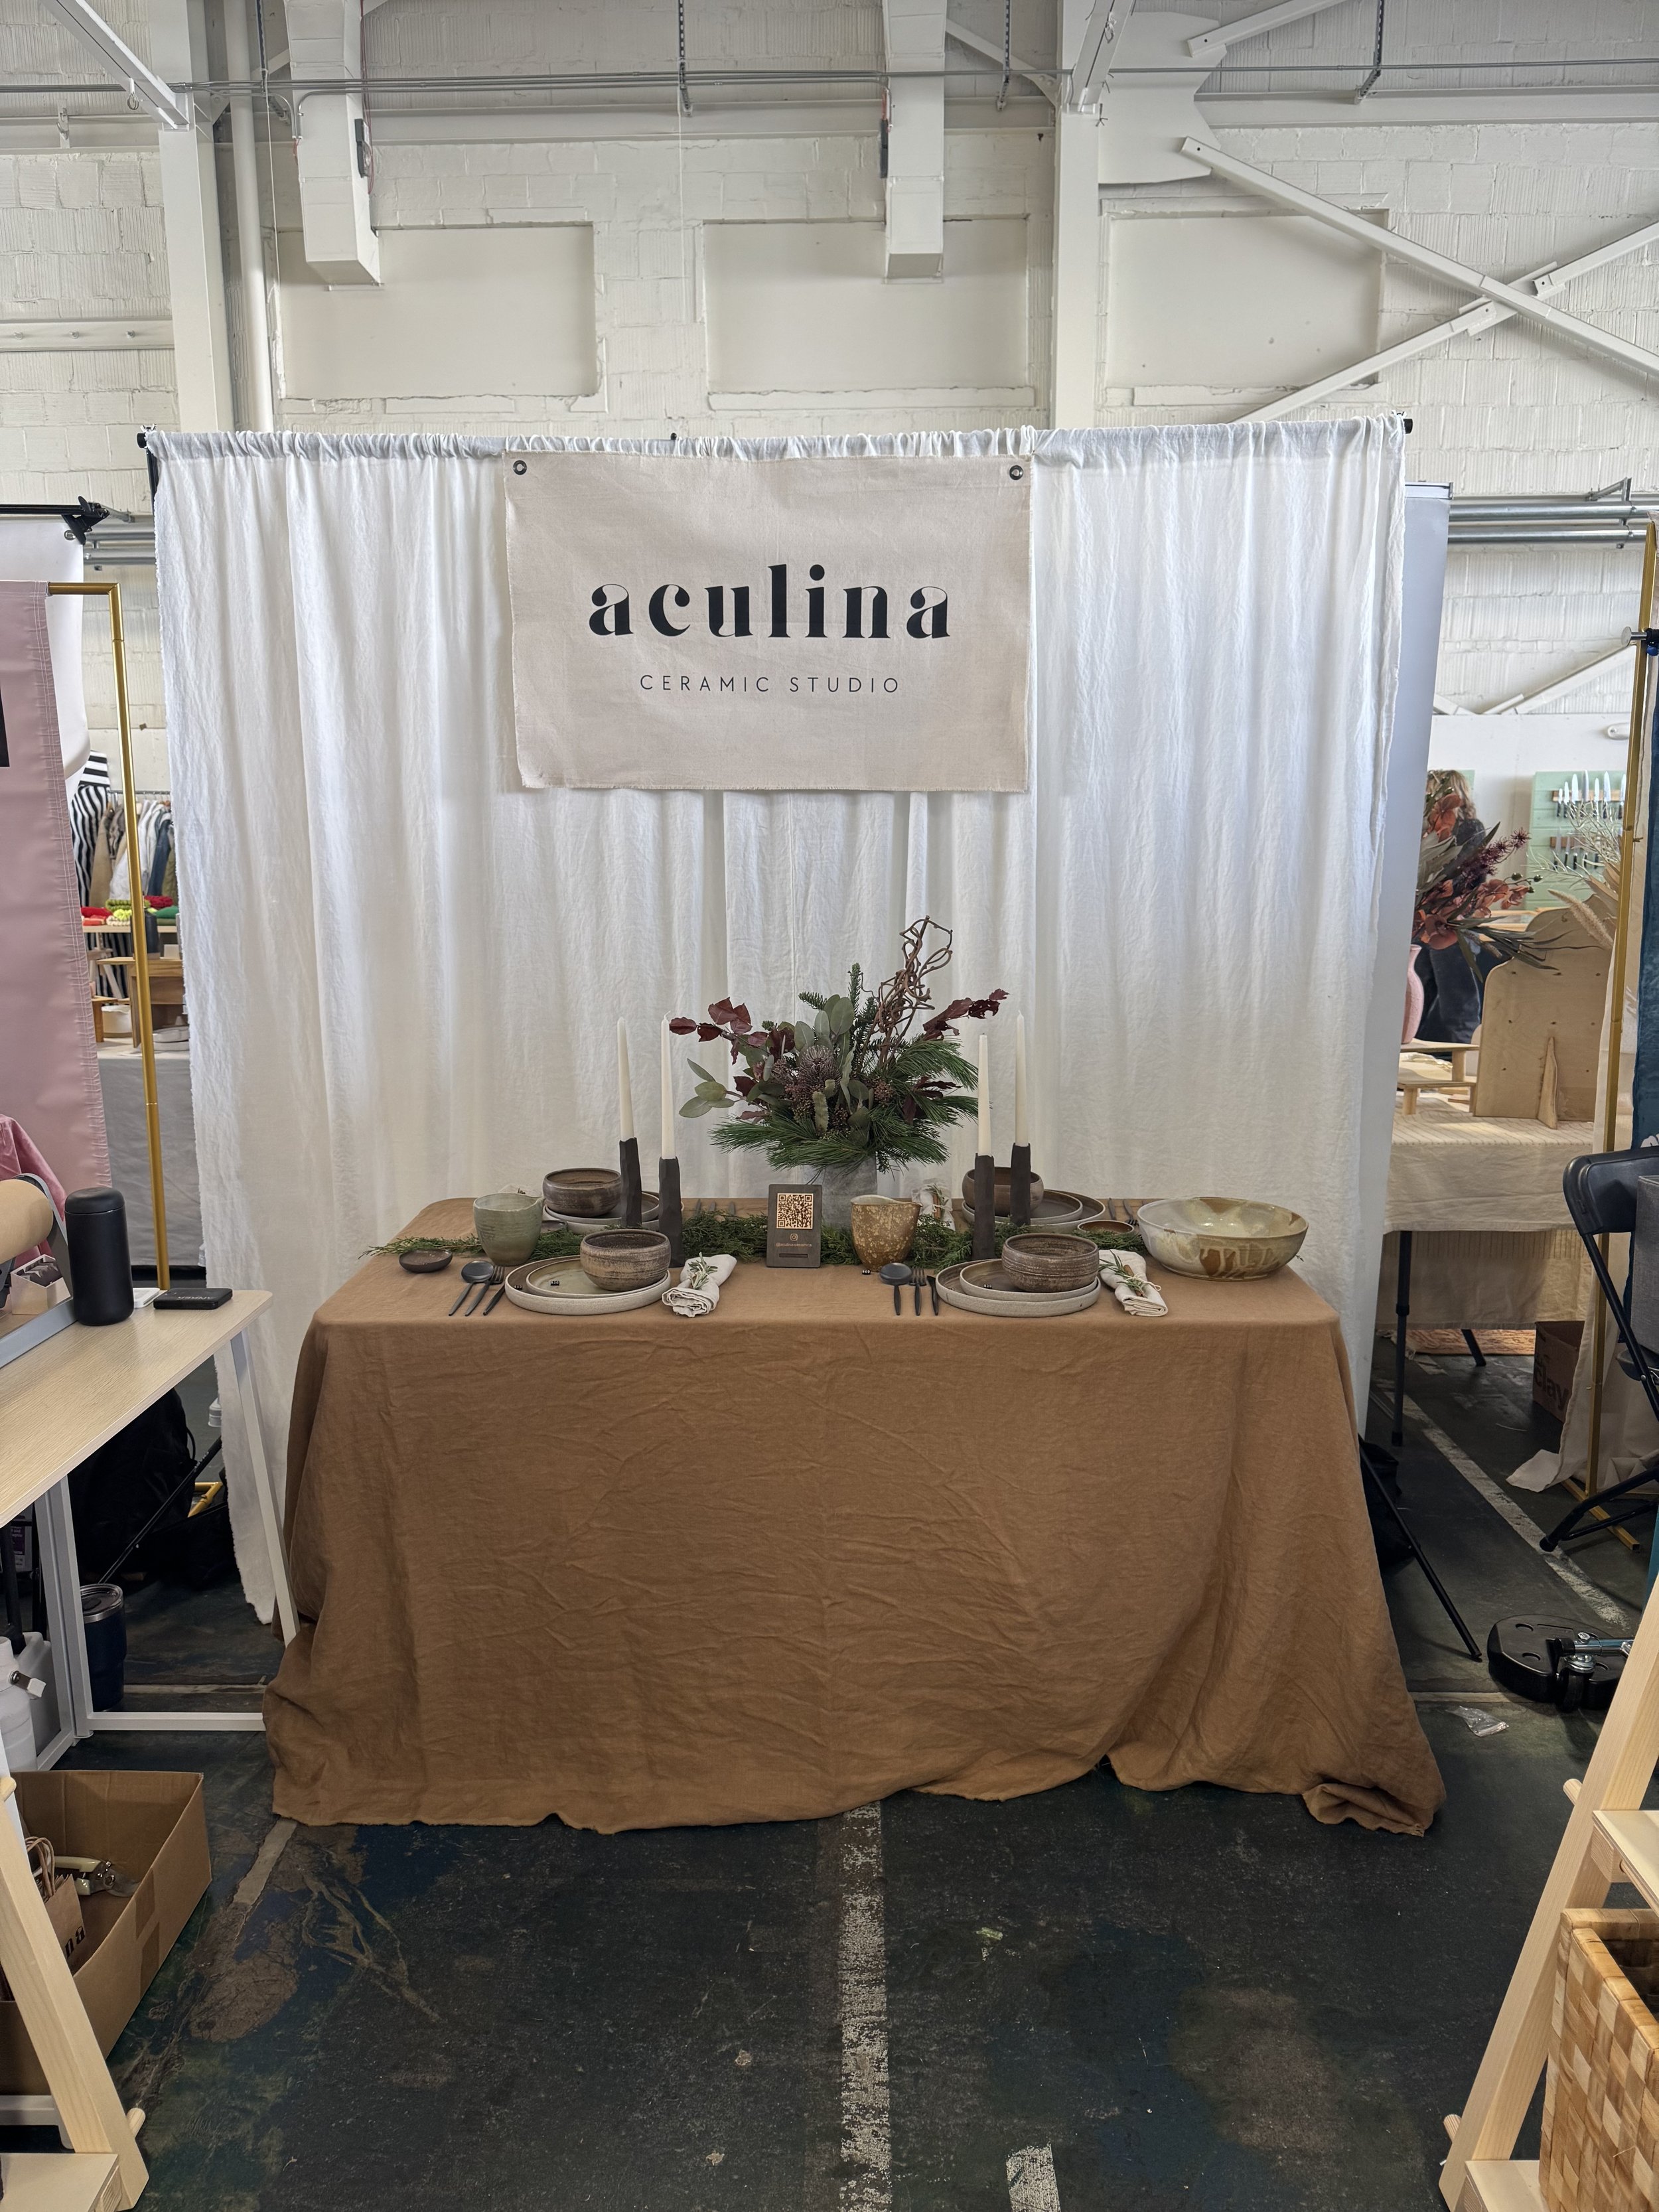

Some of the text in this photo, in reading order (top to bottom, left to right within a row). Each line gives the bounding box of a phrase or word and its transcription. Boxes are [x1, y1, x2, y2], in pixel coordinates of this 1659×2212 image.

[589, 563, 950, 639] aculina
[640, 674, 898, 693] CERAMIC STUDIO
[1534, 1365, 1569, 1411] clay
